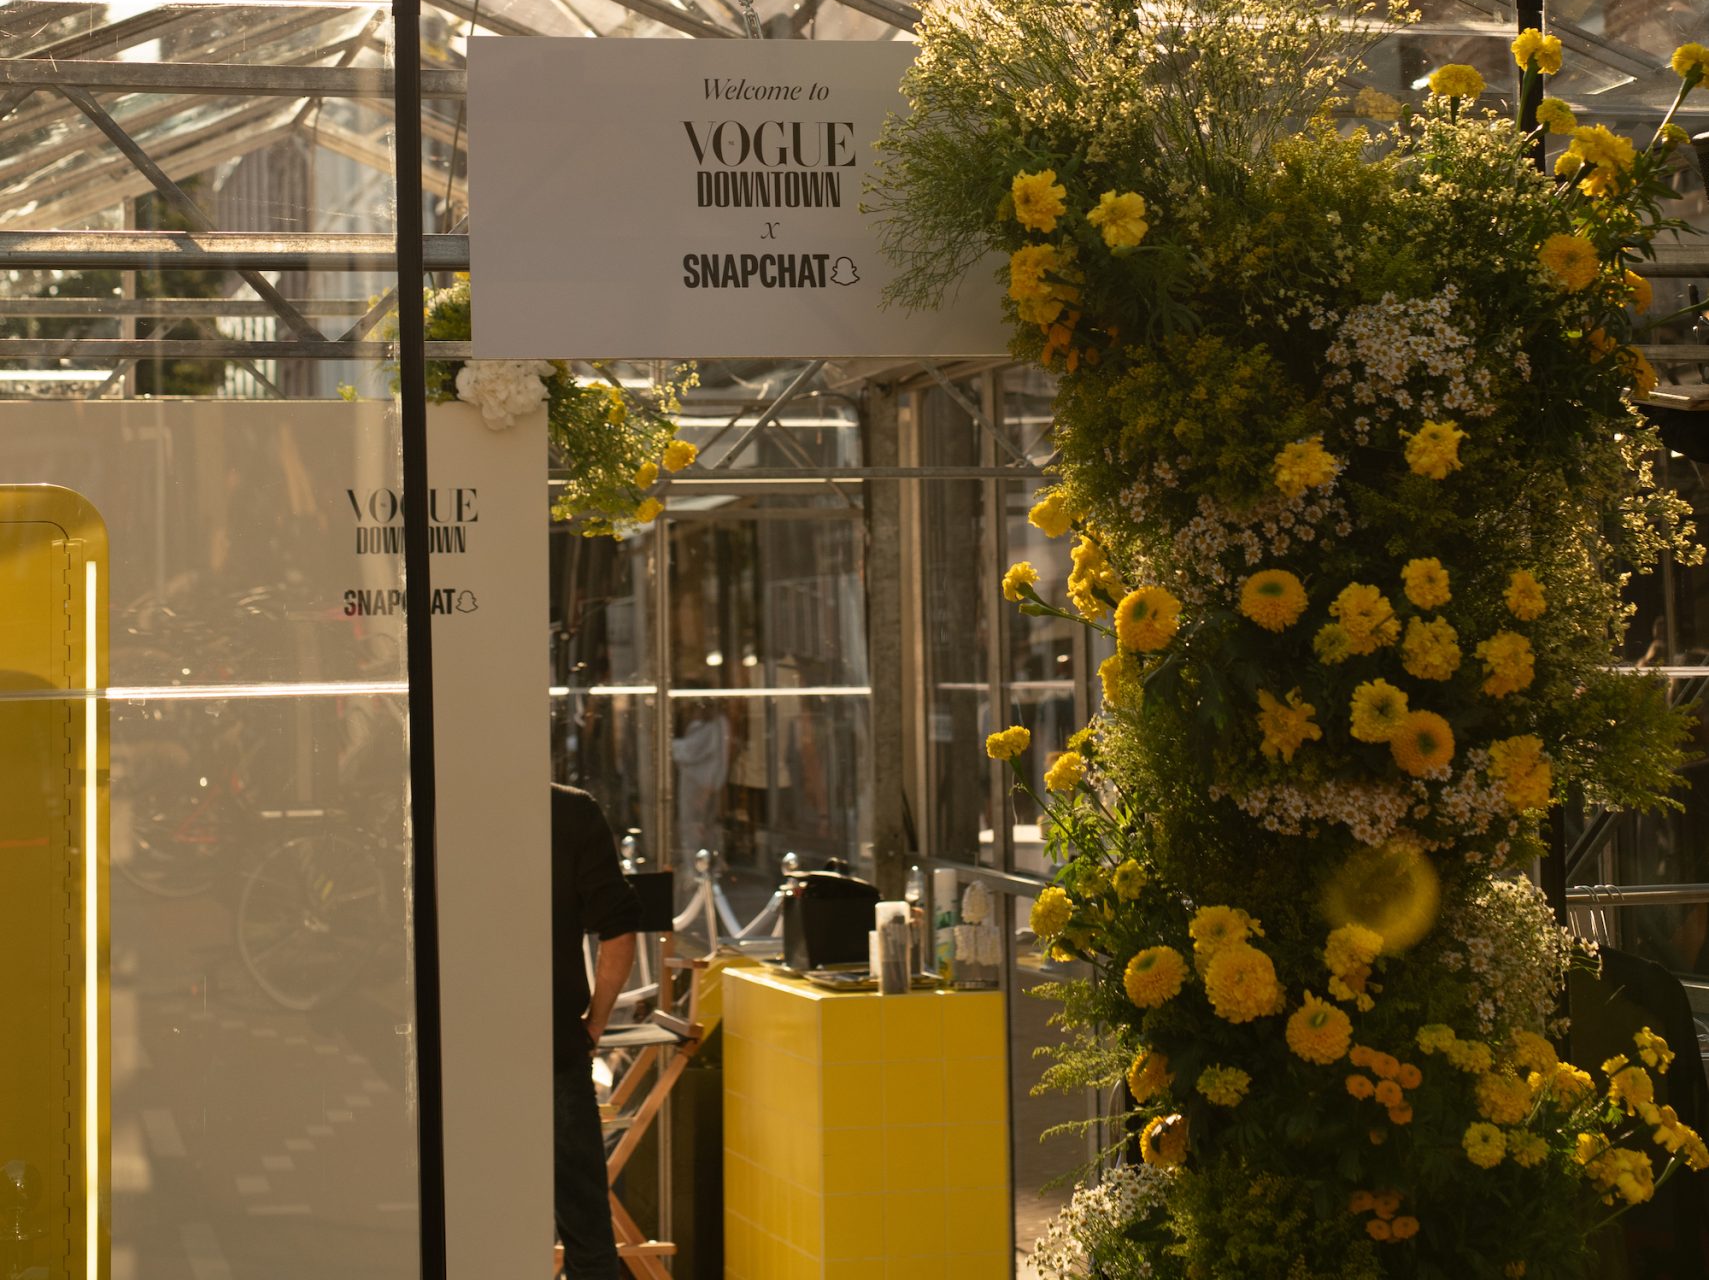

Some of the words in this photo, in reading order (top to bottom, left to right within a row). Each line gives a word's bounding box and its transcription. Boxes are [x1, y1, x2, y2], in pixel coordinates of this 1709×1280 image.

[703, 78, 802, 101] Welcome
[809, 82, 829, 101] to
[680, 120, 856, 167] VOGUE
[697, 171, 840, 208] DOWNTOWN
[760, 222, 780, 240] x
[683, 253, 829, 288] SNAPCHAT
[346, 487, 479, 523] VOUE
[356, 526, 466, 554] DOWWN
[343, 588, 456, 616] SNAPAT
